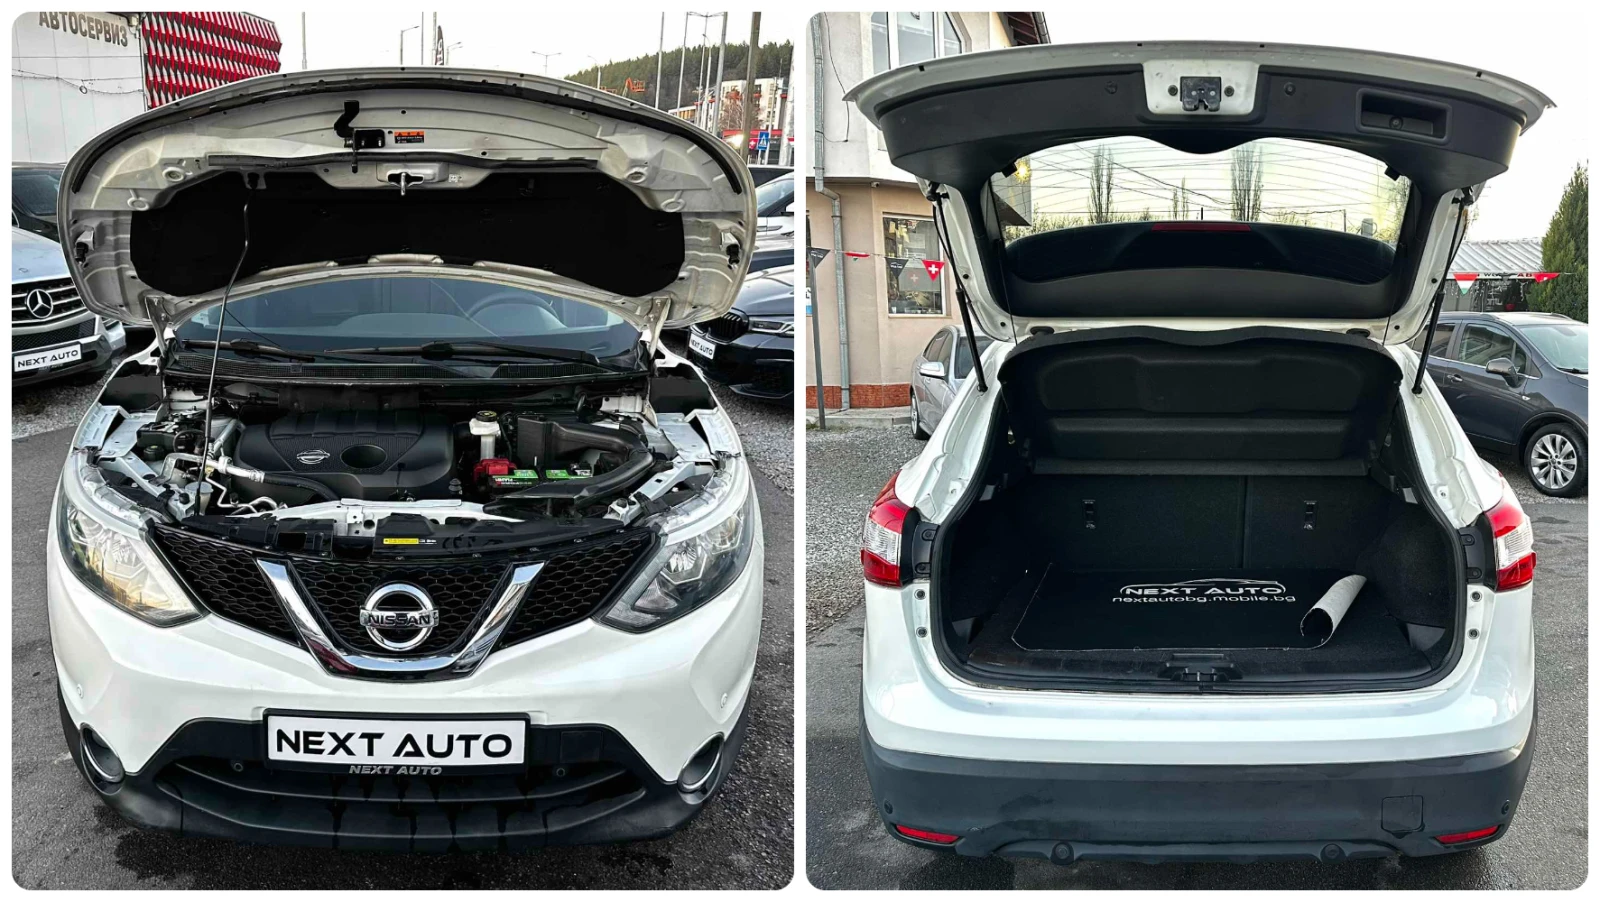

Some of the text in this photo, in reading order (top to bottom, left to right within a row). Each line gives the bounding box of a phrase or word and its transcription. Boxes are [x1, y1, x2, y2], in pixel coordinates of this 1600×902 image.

[39, 12, 128, 47] АВТОСЕРВИЗ
[700, 345, 713, 356] AUTO
[17, 349, 79, 368] NEXT AUTO
[1125, 587, 1283, 595] NEXT AUTO
[1112, 595, 1296, 603] nextautobg.mobile.bg
[368, 614, 431, 626] NISSAN
[276, 728, 513, 758] NEXT AUTO
[349, 765, 443, 776] NEXT AUTO
